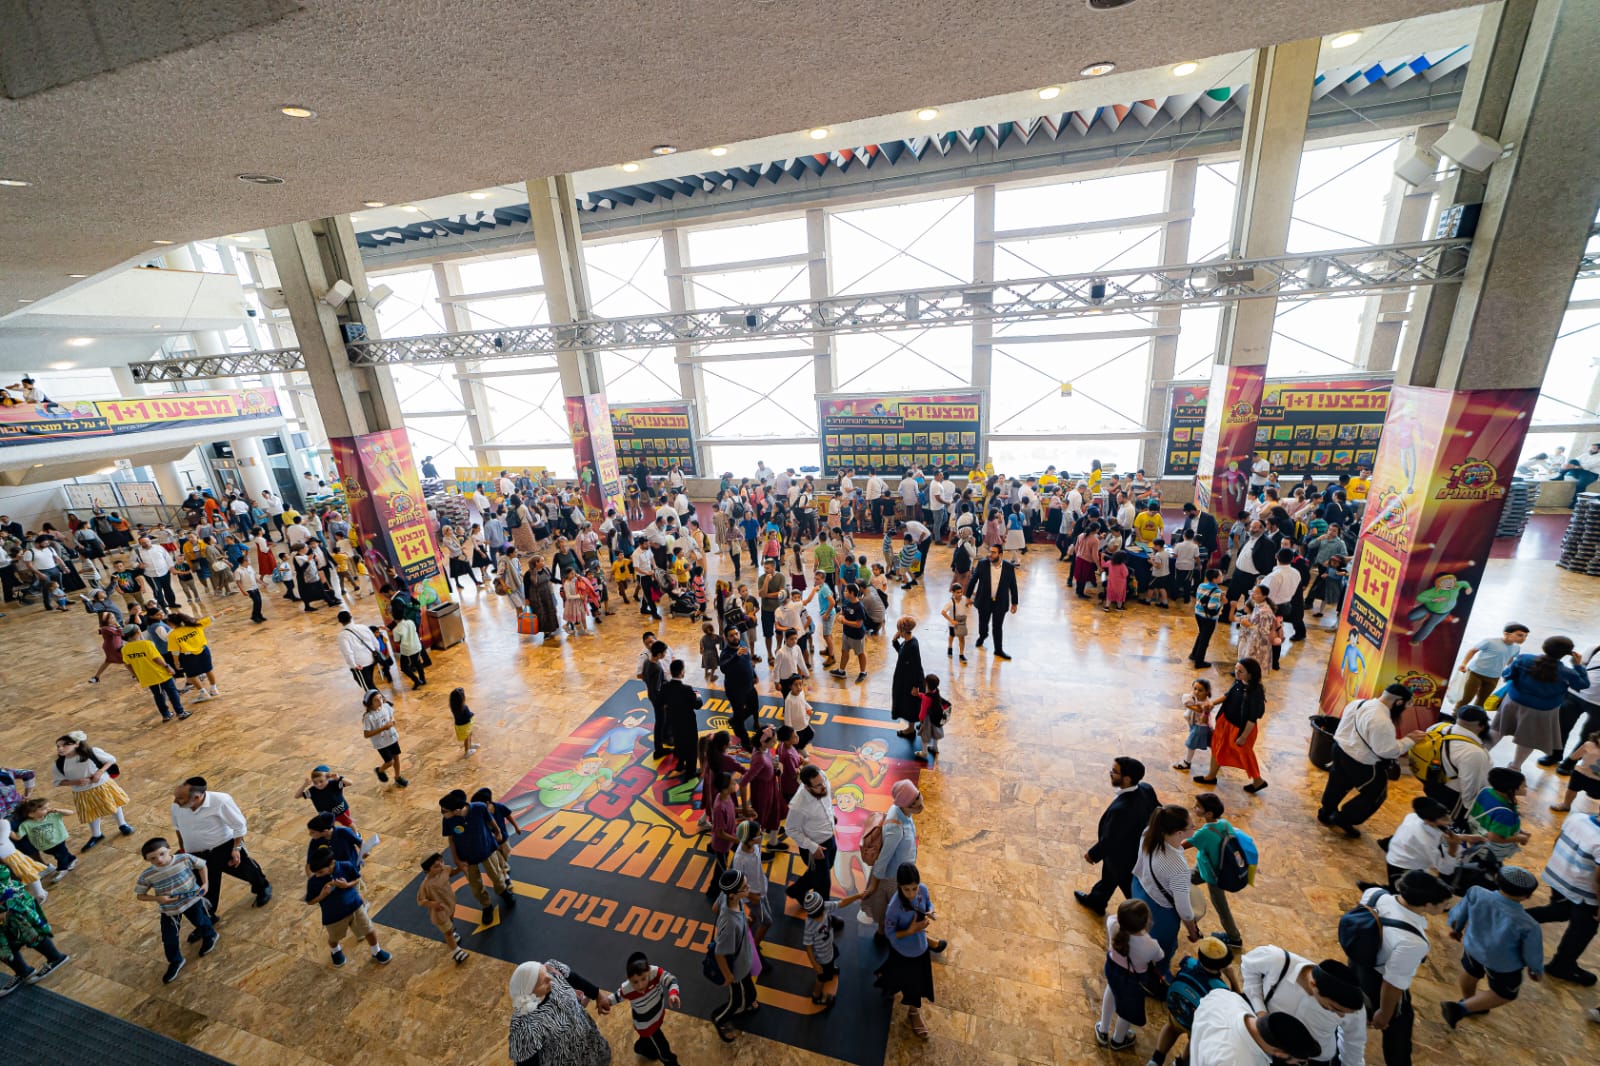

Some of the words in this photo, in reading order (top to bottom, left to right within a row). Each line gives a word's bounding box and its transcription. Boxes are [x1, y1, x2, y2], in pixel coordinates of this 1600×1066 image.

[1285, 393, 1314, 408] 1+1
[1318, 394, 1387, 408] מבצע!
[107, 403, 150, 421] 1+1
[152, 399, 231, 418] מבצע!
[903, 406, 923, 418] 1+1
[926, 406, 975, 419] מבצע!
[30, 423, 62, 432] מוצרי
[63, 421, 79, 430] כל
[80, 420, 96, 429] על
[630, 416, 647, 426] 1+1
[648, 416, 686, 427] מבצע!
[395, 529, 426, 545] מבצע!
[401, 539, 429, 561] 1+1
[1364, 548, 1397, 581] מבצע!
[1362, 567, 1390, 608] 1+1
[1367, 609, 1376, 622] כל
[1375, 616, 1385, 629] על
[543, 888, 619, 928] בנים
[614, 905, 715, 954] כניסת
